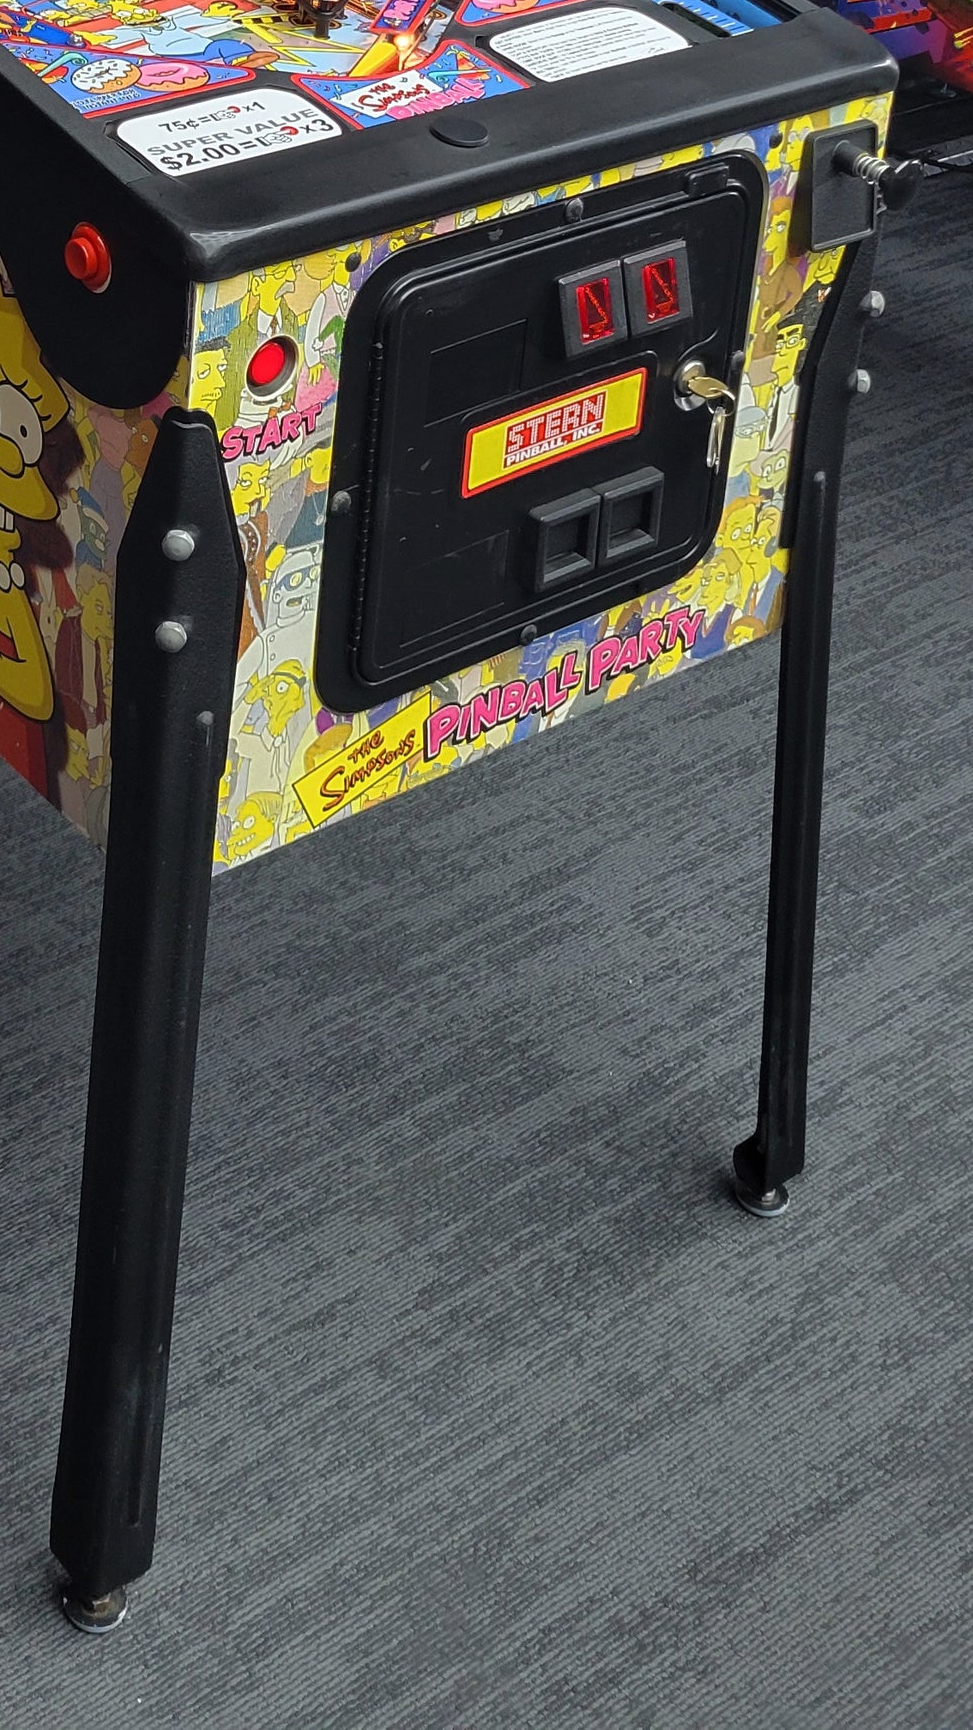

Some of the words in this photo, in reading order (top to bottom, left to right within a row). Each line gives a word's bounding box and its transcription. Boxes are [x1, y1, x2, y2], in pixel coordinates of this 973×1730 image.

[147, 131, 234, 156] SUPER
[234, 108, 320, 136] VALUE
[222, 402, 323, 462] START
[507, 393, 604, 454] STERN
[572, 423, 601, 441] INC.
[423, 650, 582, 762] PINBALL
[584, 605, 708, 694] PARTY
